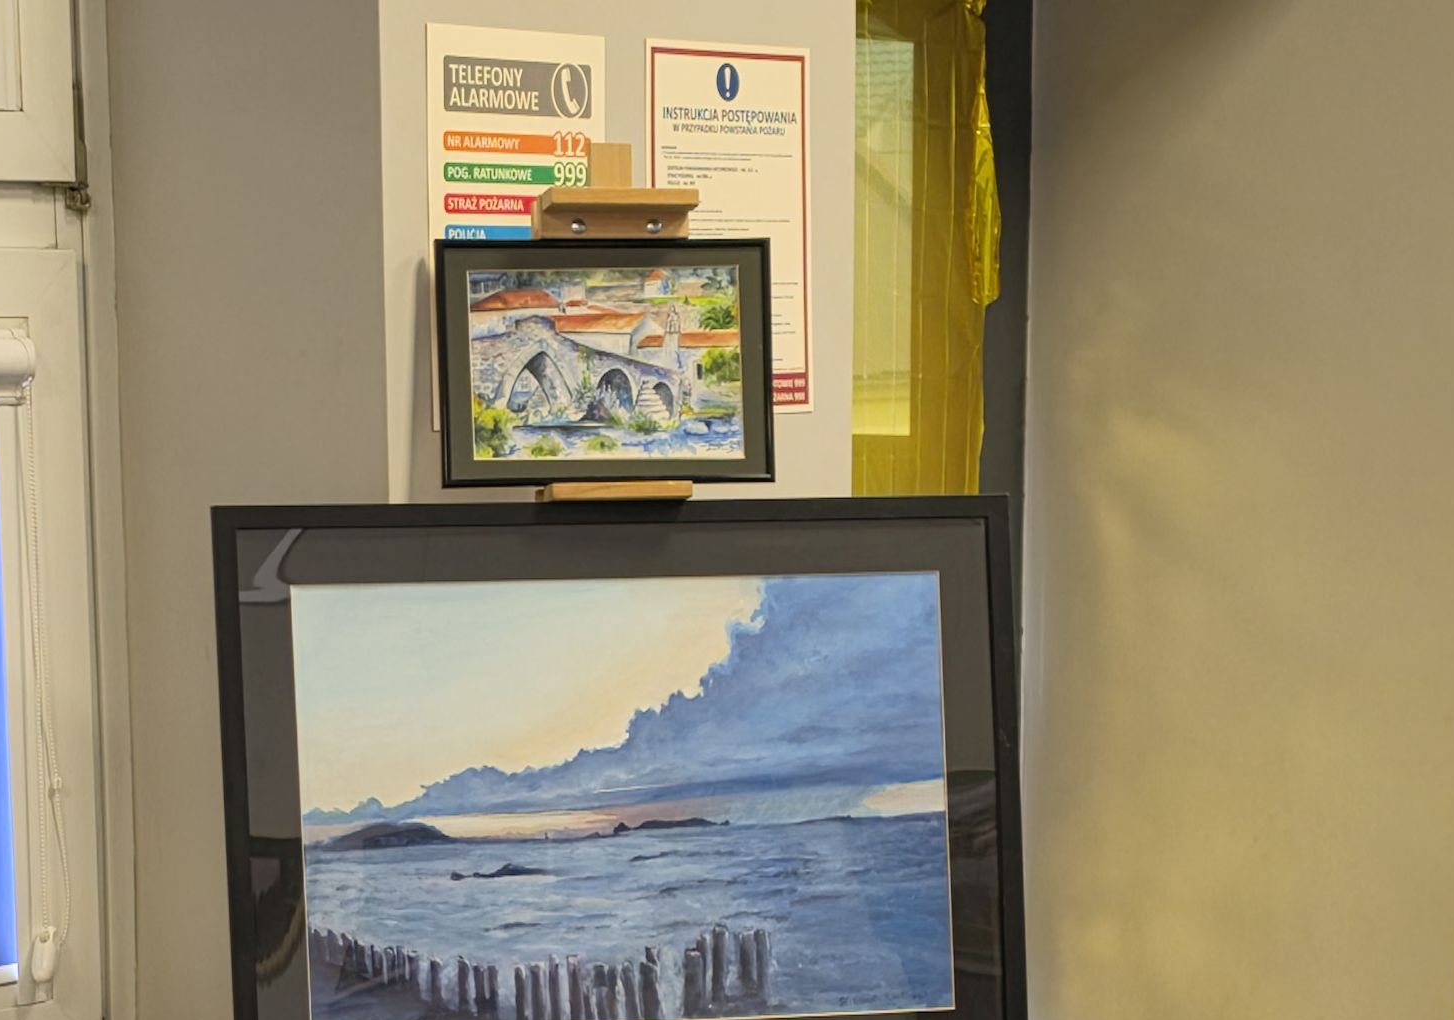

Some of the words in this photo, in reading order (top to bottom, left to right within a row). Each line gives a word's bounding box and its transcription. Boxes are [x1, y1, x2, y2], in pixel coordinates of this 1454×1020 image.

[449, 63, 524, 88] TELEFONY
[450, 86, 540, 111] ALARMOWE
[662, 106, 720, 123] INSTRUKCJA
[721, 109, 798, 126] POSTĘPOWANIA
[447, 136, 461, 147] NR
[463, 136, 520, 149] ALARMOWY
[553, 131, 586, 157] 112
[447, 167, 471, 179] POG.
[473, 168, 532, 181] RATUNKOWE
[554, 162, 587, 187] 999
[448, 196, 477, 210] STRAŻ
[479, 197, 524, 211] POŻARNA
